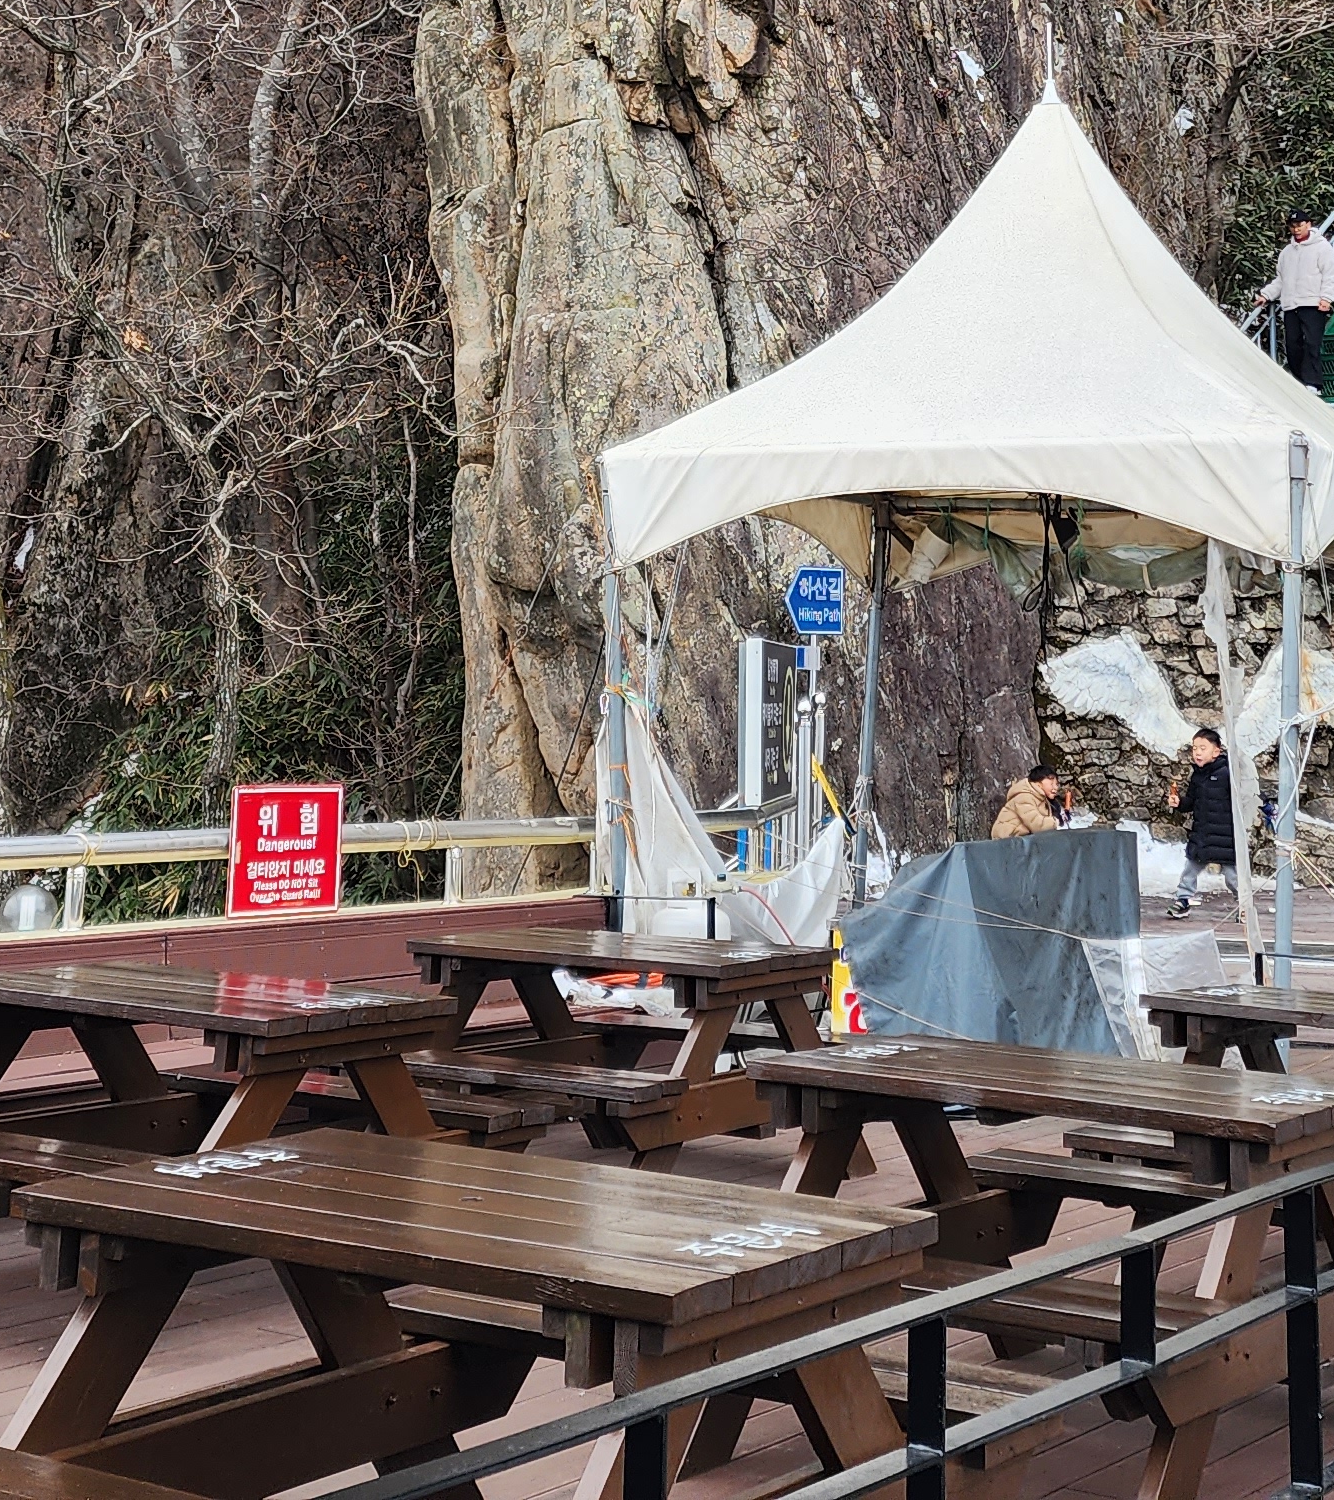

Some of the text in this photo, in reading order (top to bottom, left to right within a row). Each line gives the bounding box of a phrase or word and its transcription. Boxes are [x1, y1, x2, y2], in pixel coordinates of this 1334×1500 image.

[799, 576, 841, 601] 하산길
[798, 607, 841, 625] Hiking Path
[257, 836, 317, 852] Dangerous!
[247, 859, 326, 879] 걸터앉지 마세요
[279, 880, 290, 889] DO
[291, 878, 307, 888] NOT
